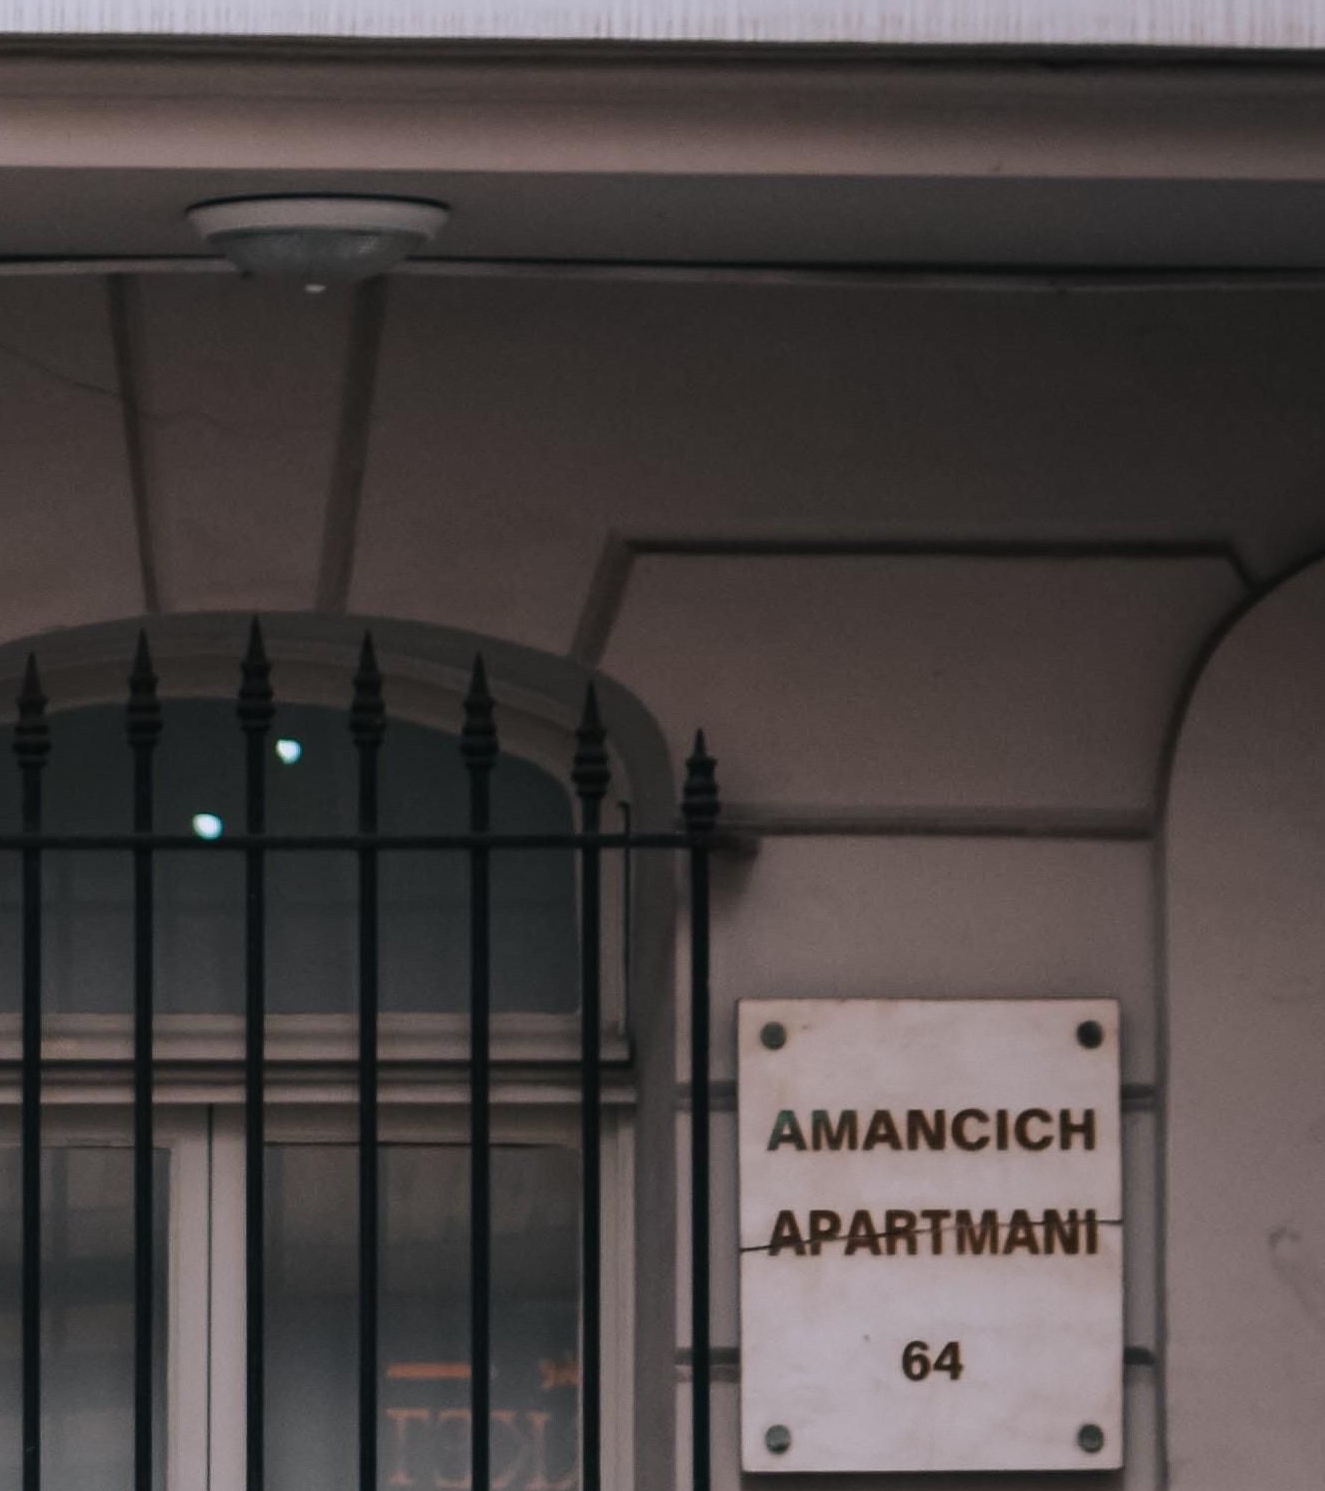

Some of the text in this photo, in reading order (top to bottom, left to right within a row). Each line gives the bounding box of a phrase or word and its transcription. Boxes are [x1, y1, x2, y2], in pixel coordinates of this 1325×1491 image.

[766, 1107, 1096, 1153] AMANCICH
[768, 1208, 1098, 1257] APARTMANI
[901, 1340, 964, 1382] 64
